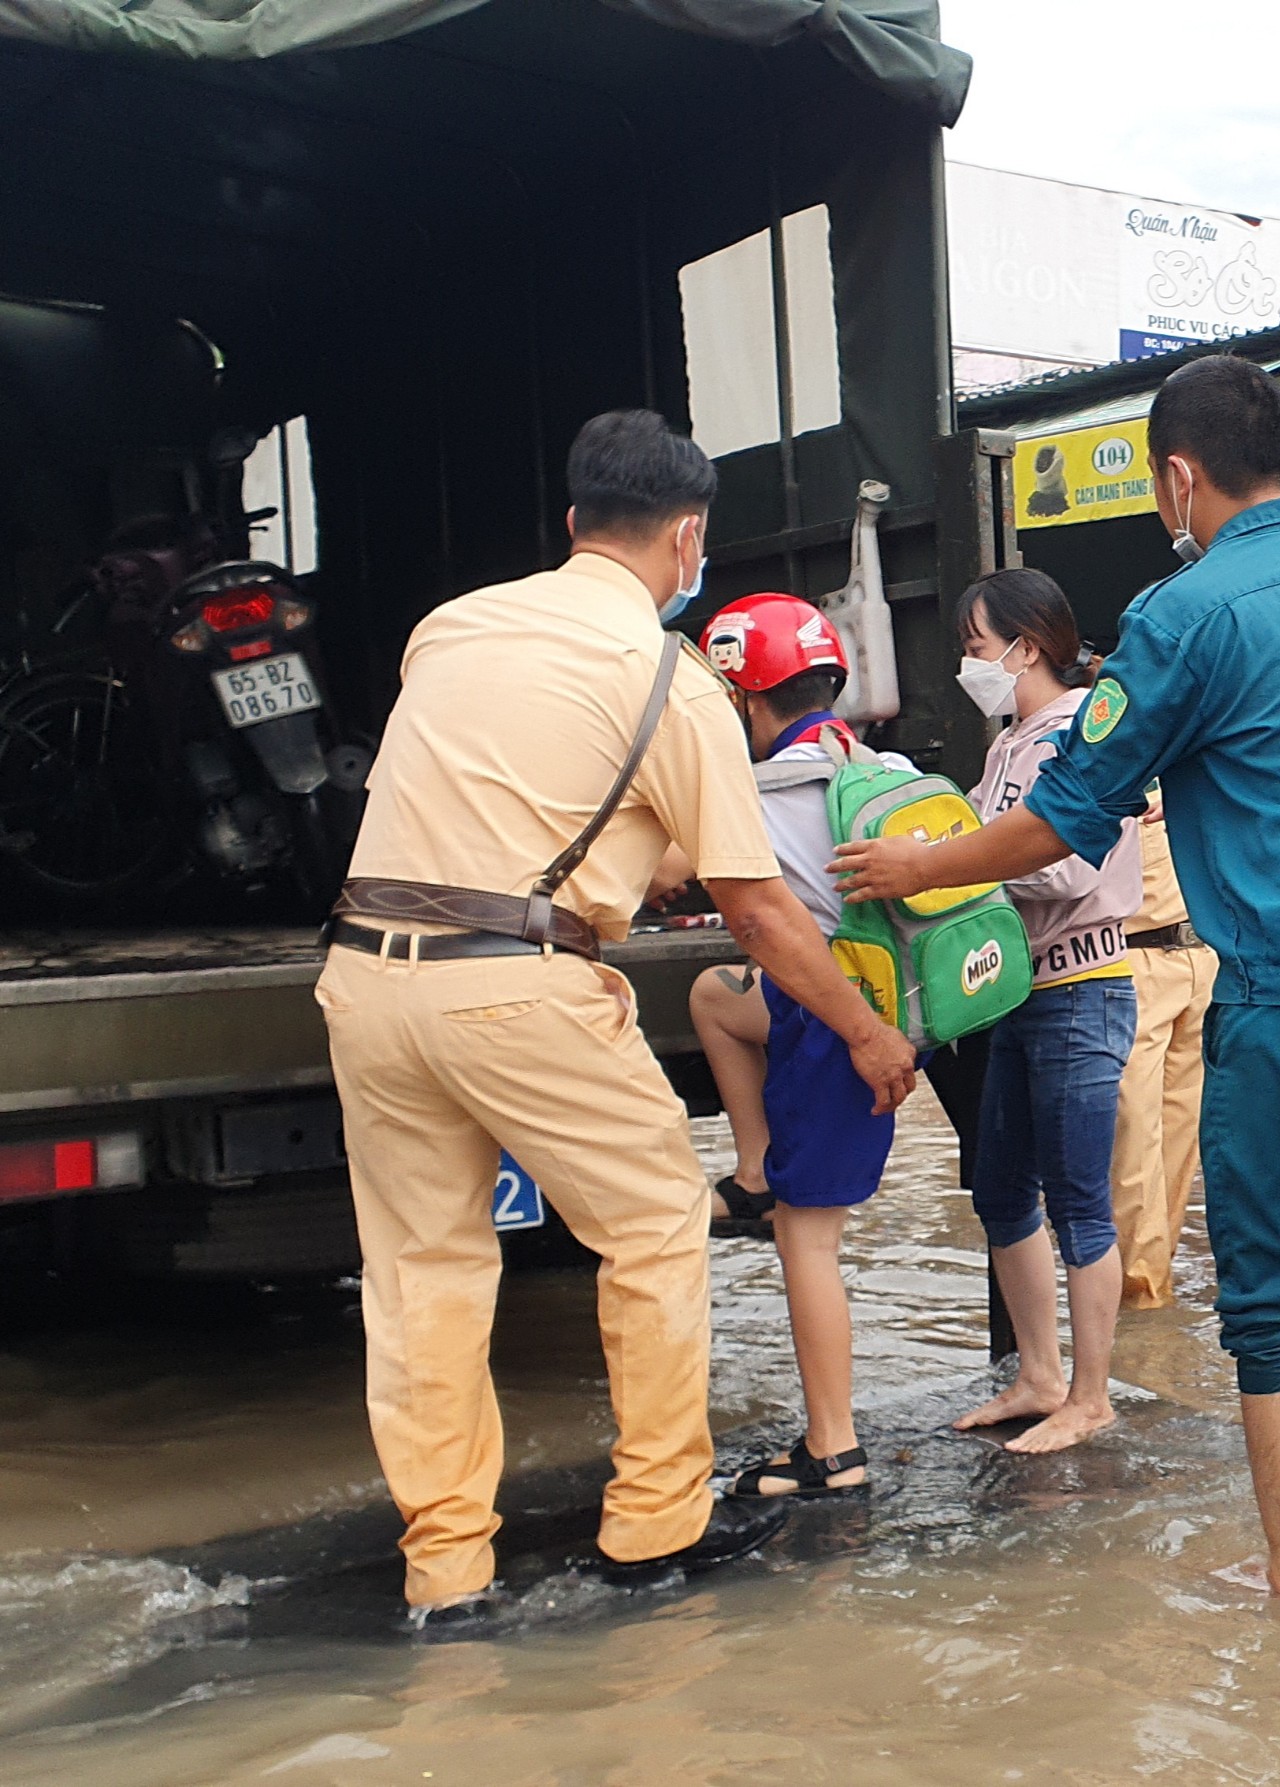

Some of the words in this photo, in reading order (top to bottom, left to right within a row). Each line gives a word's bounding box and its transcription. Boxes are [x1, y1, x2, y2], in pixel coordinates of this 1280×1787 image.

[1125, 208, 1170, 237] Quán
[1169, 214, 1218, 244] Nhậu
[1148, 314, 1187, 333] PHỤC
[1189, 320, 1209, 337] VỤ
[1097, 445, 1128, 468] 104
[967, 951, 999, 984] MILO
[494, 1170, 525, 1224] 2
